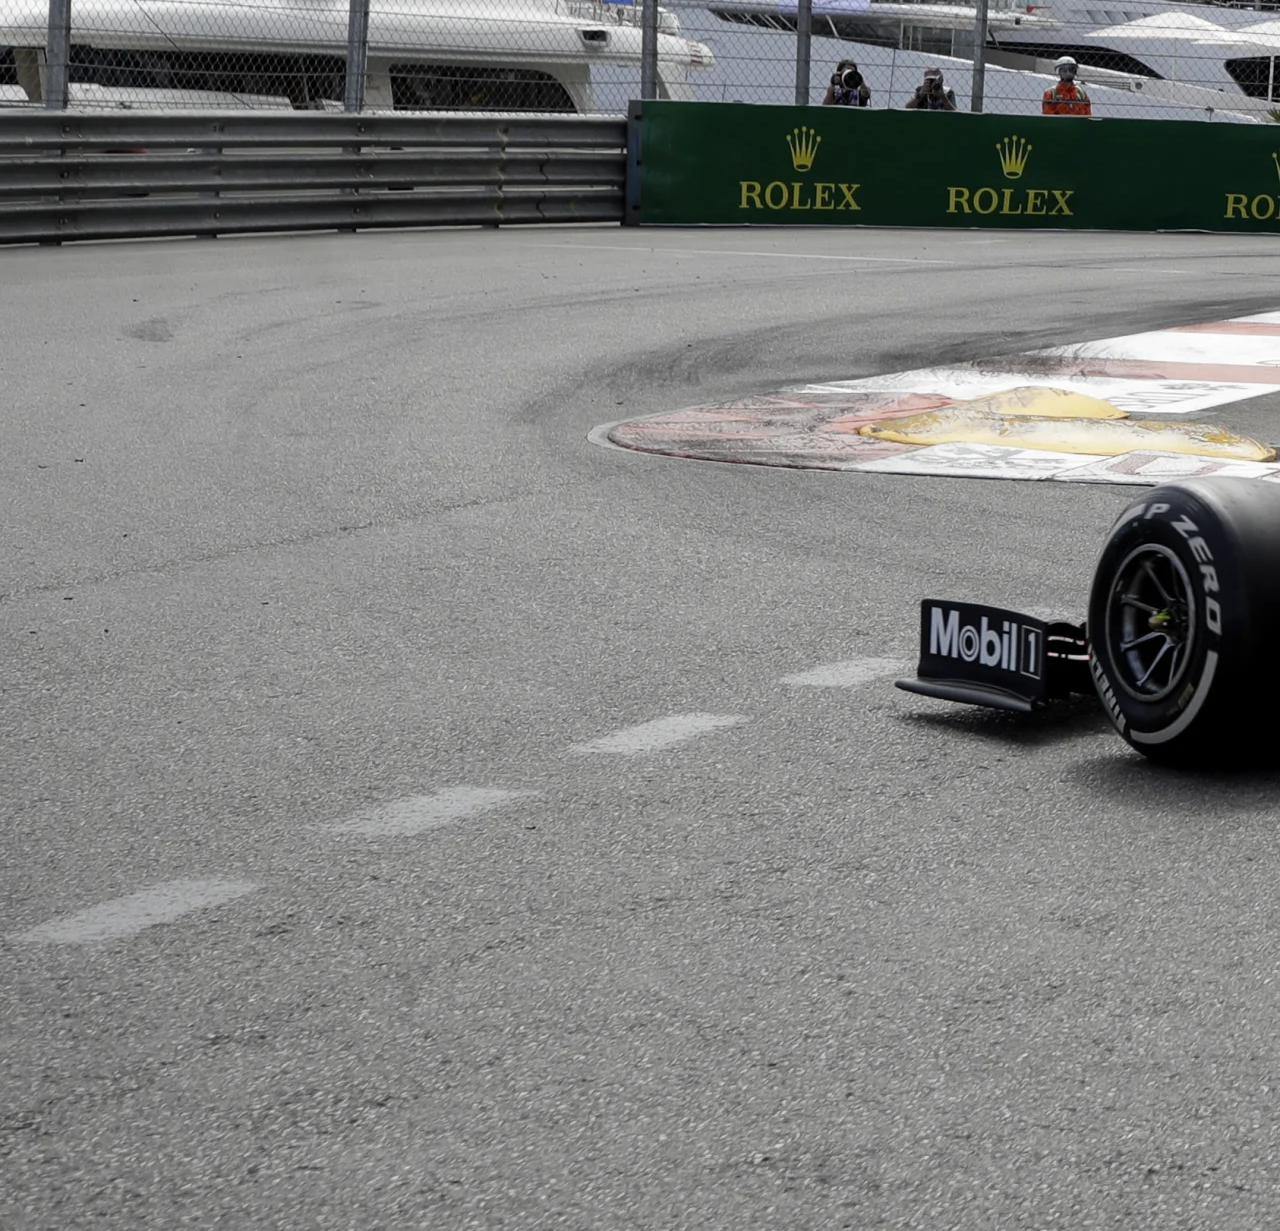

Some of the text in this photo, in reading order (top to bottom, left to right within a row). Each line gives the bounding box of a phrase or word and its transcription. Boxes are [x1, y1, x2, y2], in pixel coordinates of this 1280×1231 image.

[738, 180, 862, 212] ROLEX
[945, 186, 1075, 217] ROLEX
[1143, 502, 1171, 520] P
[1170, 514, 1224, 638] ZERO
[929, 605, 1018, 672] Mobil
